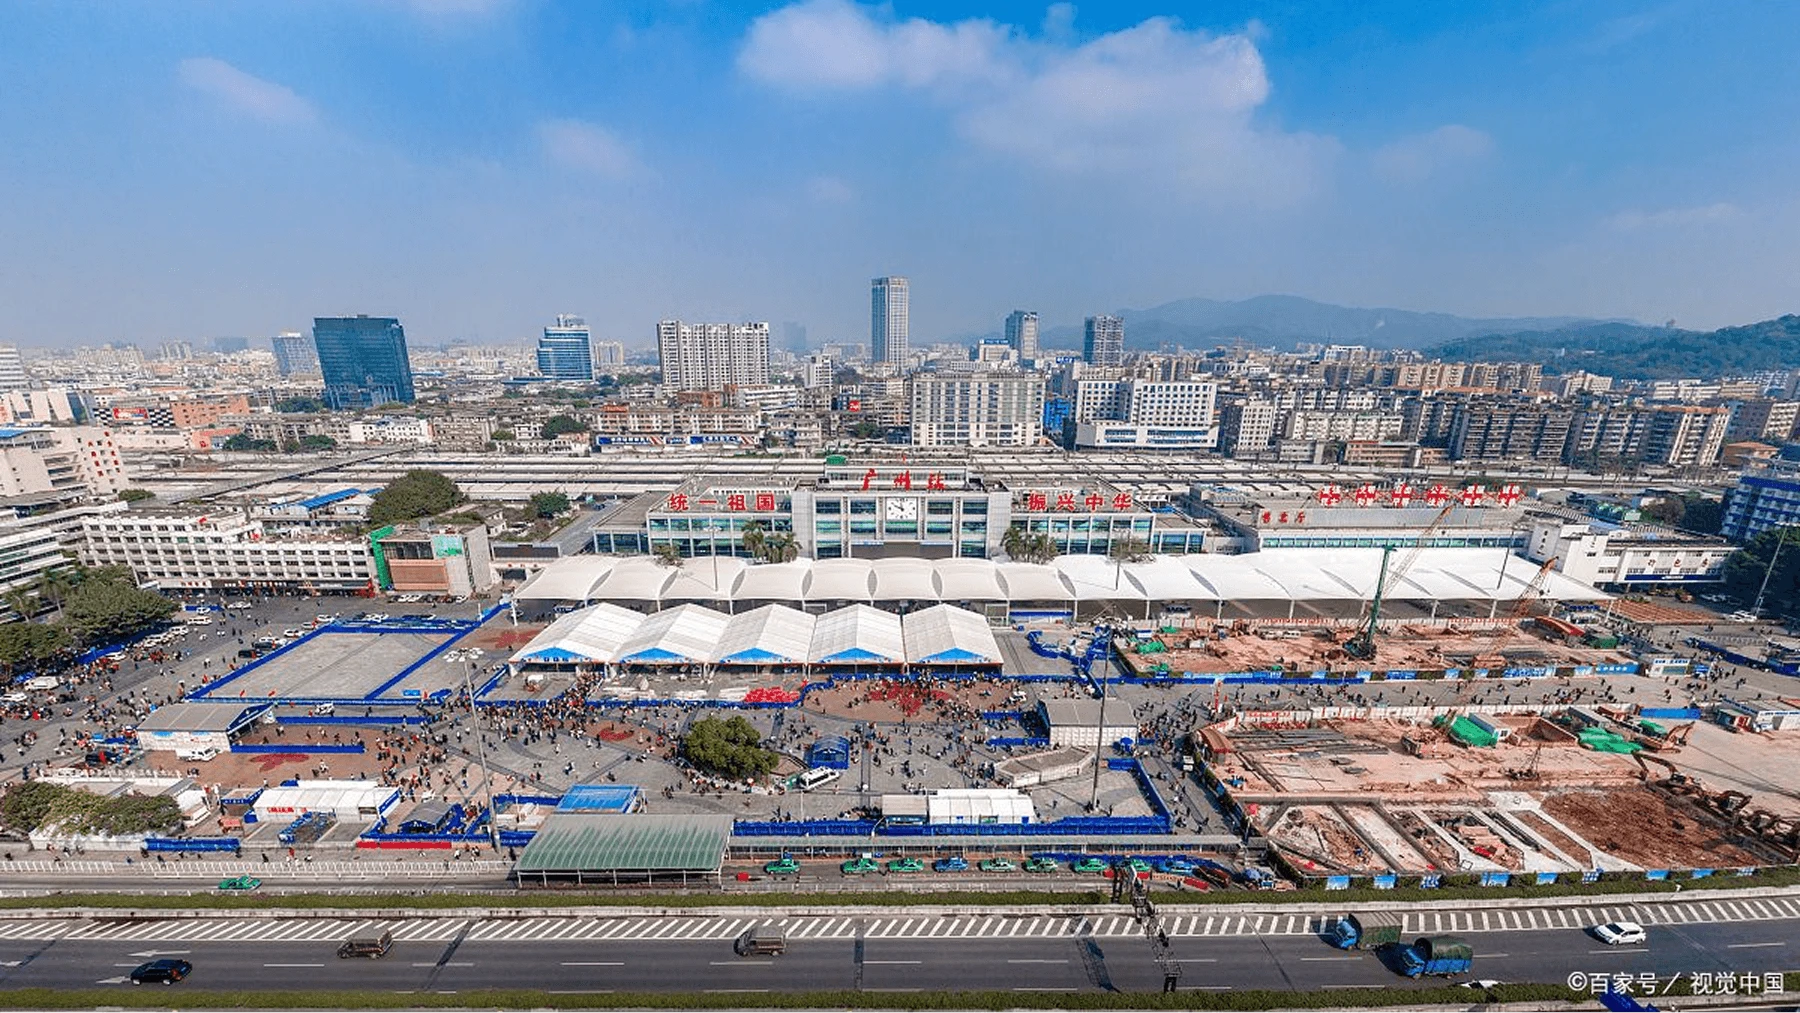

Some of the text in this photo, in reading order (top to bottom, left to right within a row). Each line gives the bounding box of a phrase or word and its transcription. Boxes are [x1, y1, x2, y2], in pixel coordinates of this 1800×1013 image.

[862, 467, 945, 491] 广州站
[669, 492, 775, 511] 统一祖国
[1027, 492, 1132, 511] 振兴中华
